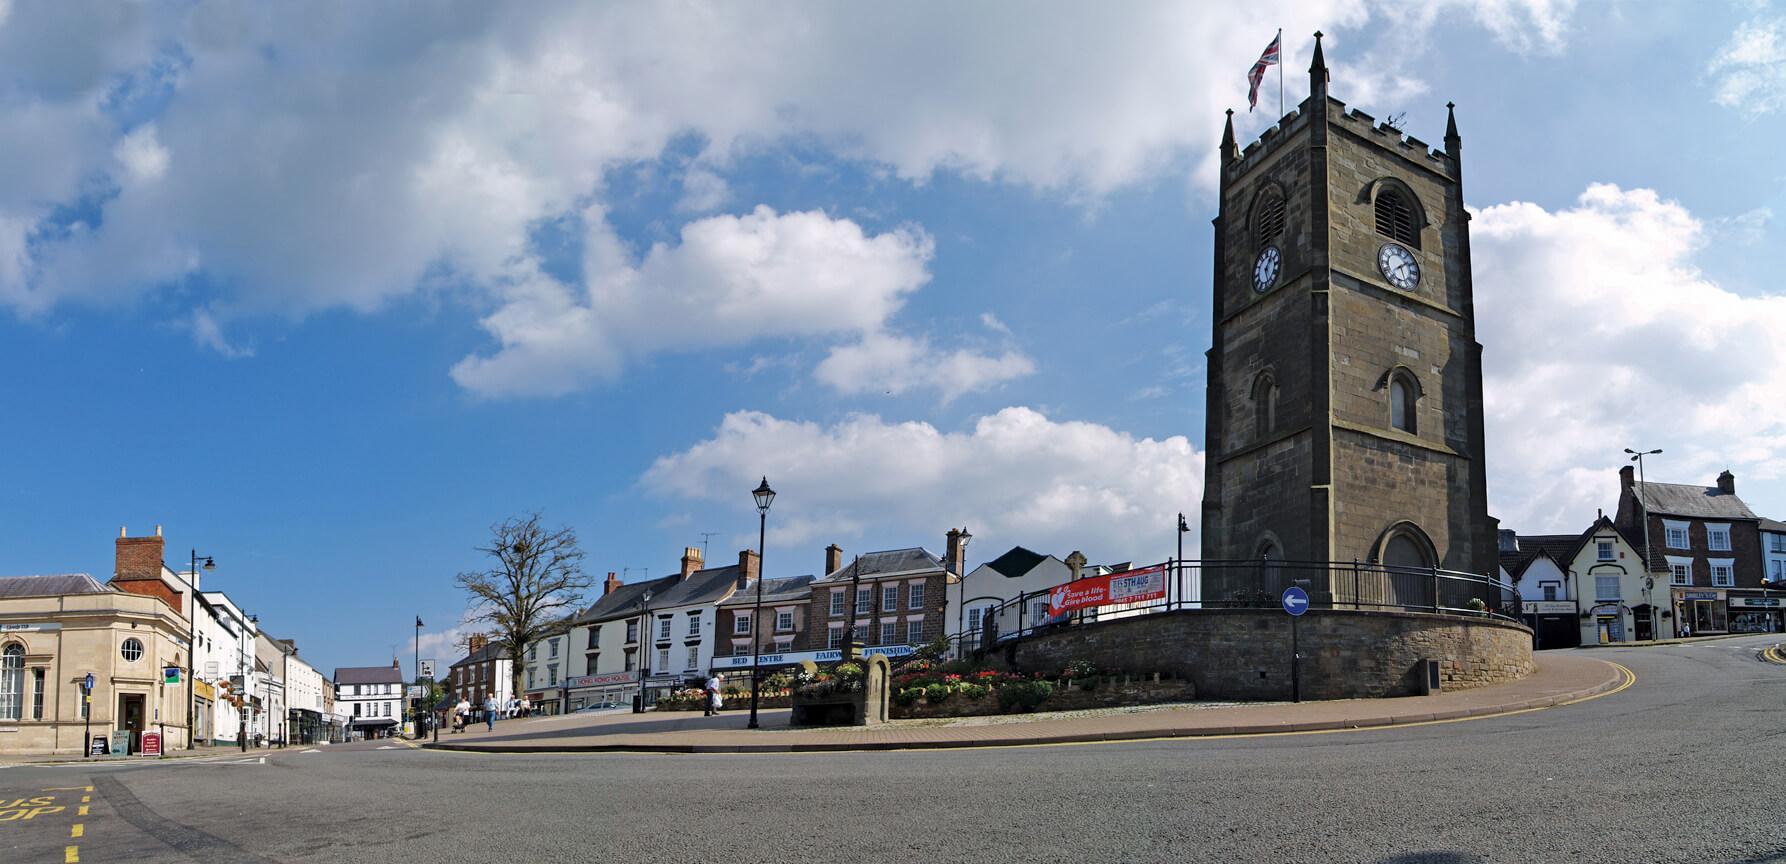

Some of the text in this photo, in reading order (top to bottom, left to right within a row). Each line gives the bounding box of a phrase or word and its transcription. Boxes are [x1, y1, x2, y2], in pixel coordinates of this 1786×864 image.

[1137, 576, 1149, 585] AUG
[1081, 594, 1104, 603] blood
[816, 646, 914, 660] FAIRW FURNISHIN
[732, 655, 784, 665] BED ENTRE
[576, 674, 630, 686] HONG KONG HOUSE
[0, 796, 55, 807] US
[0, 806, 65, 821] OP
